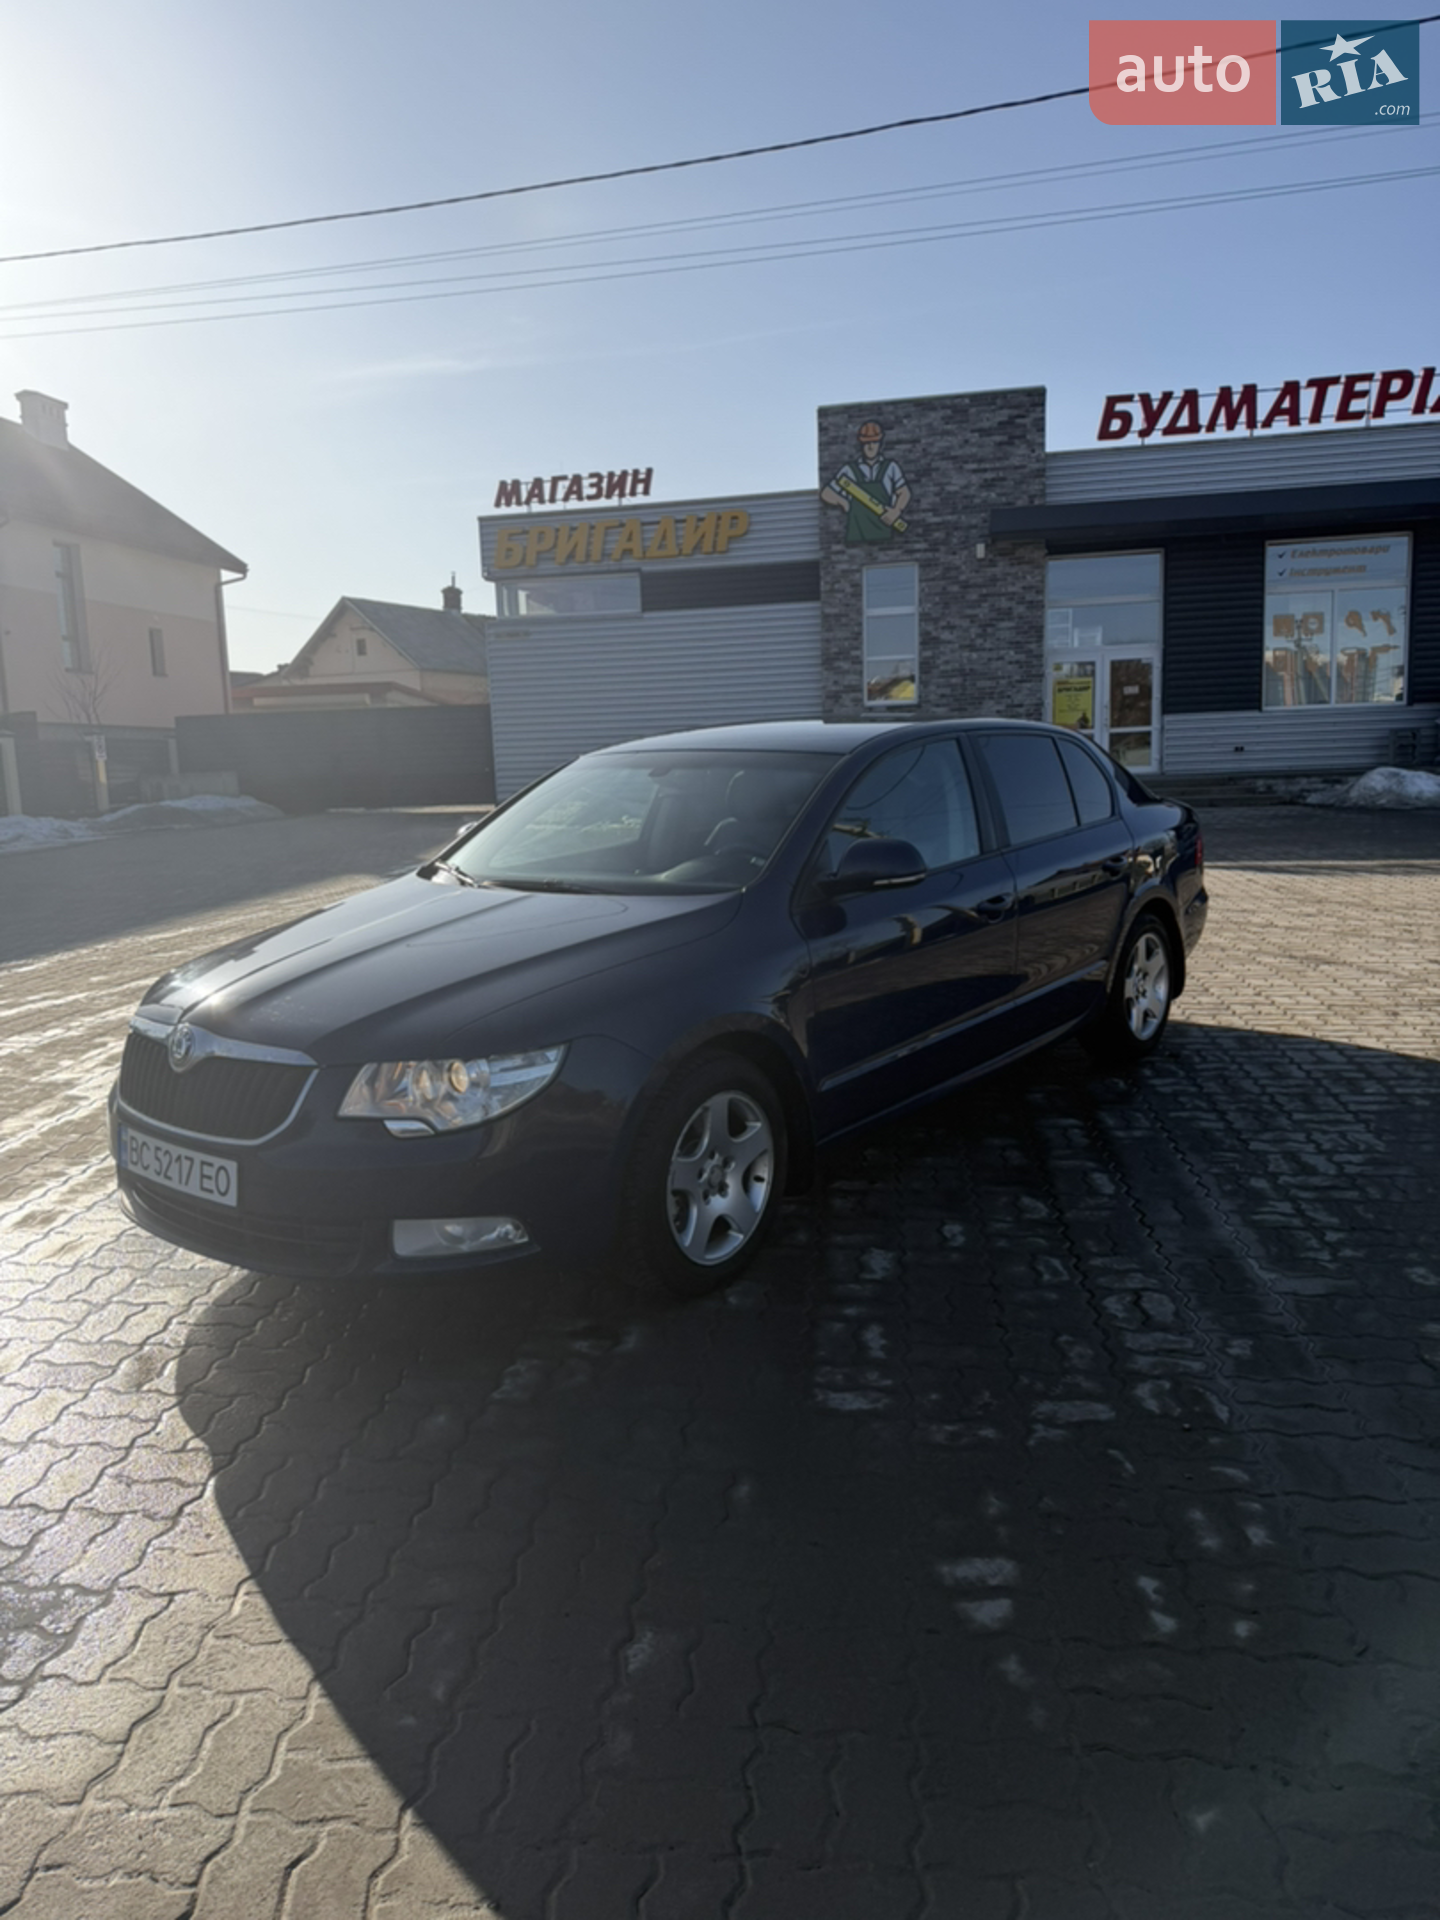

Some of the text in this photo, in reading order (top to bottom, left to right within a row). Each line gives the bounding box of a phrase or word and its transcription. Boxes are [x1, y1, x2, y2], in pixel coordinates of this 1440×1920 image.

[494, 467, 653, 508] МАГАЗИН
[494, 509, 750, 570] БРИГАДИР
[129, 1137, 231, 1197] BC 5217 EO
